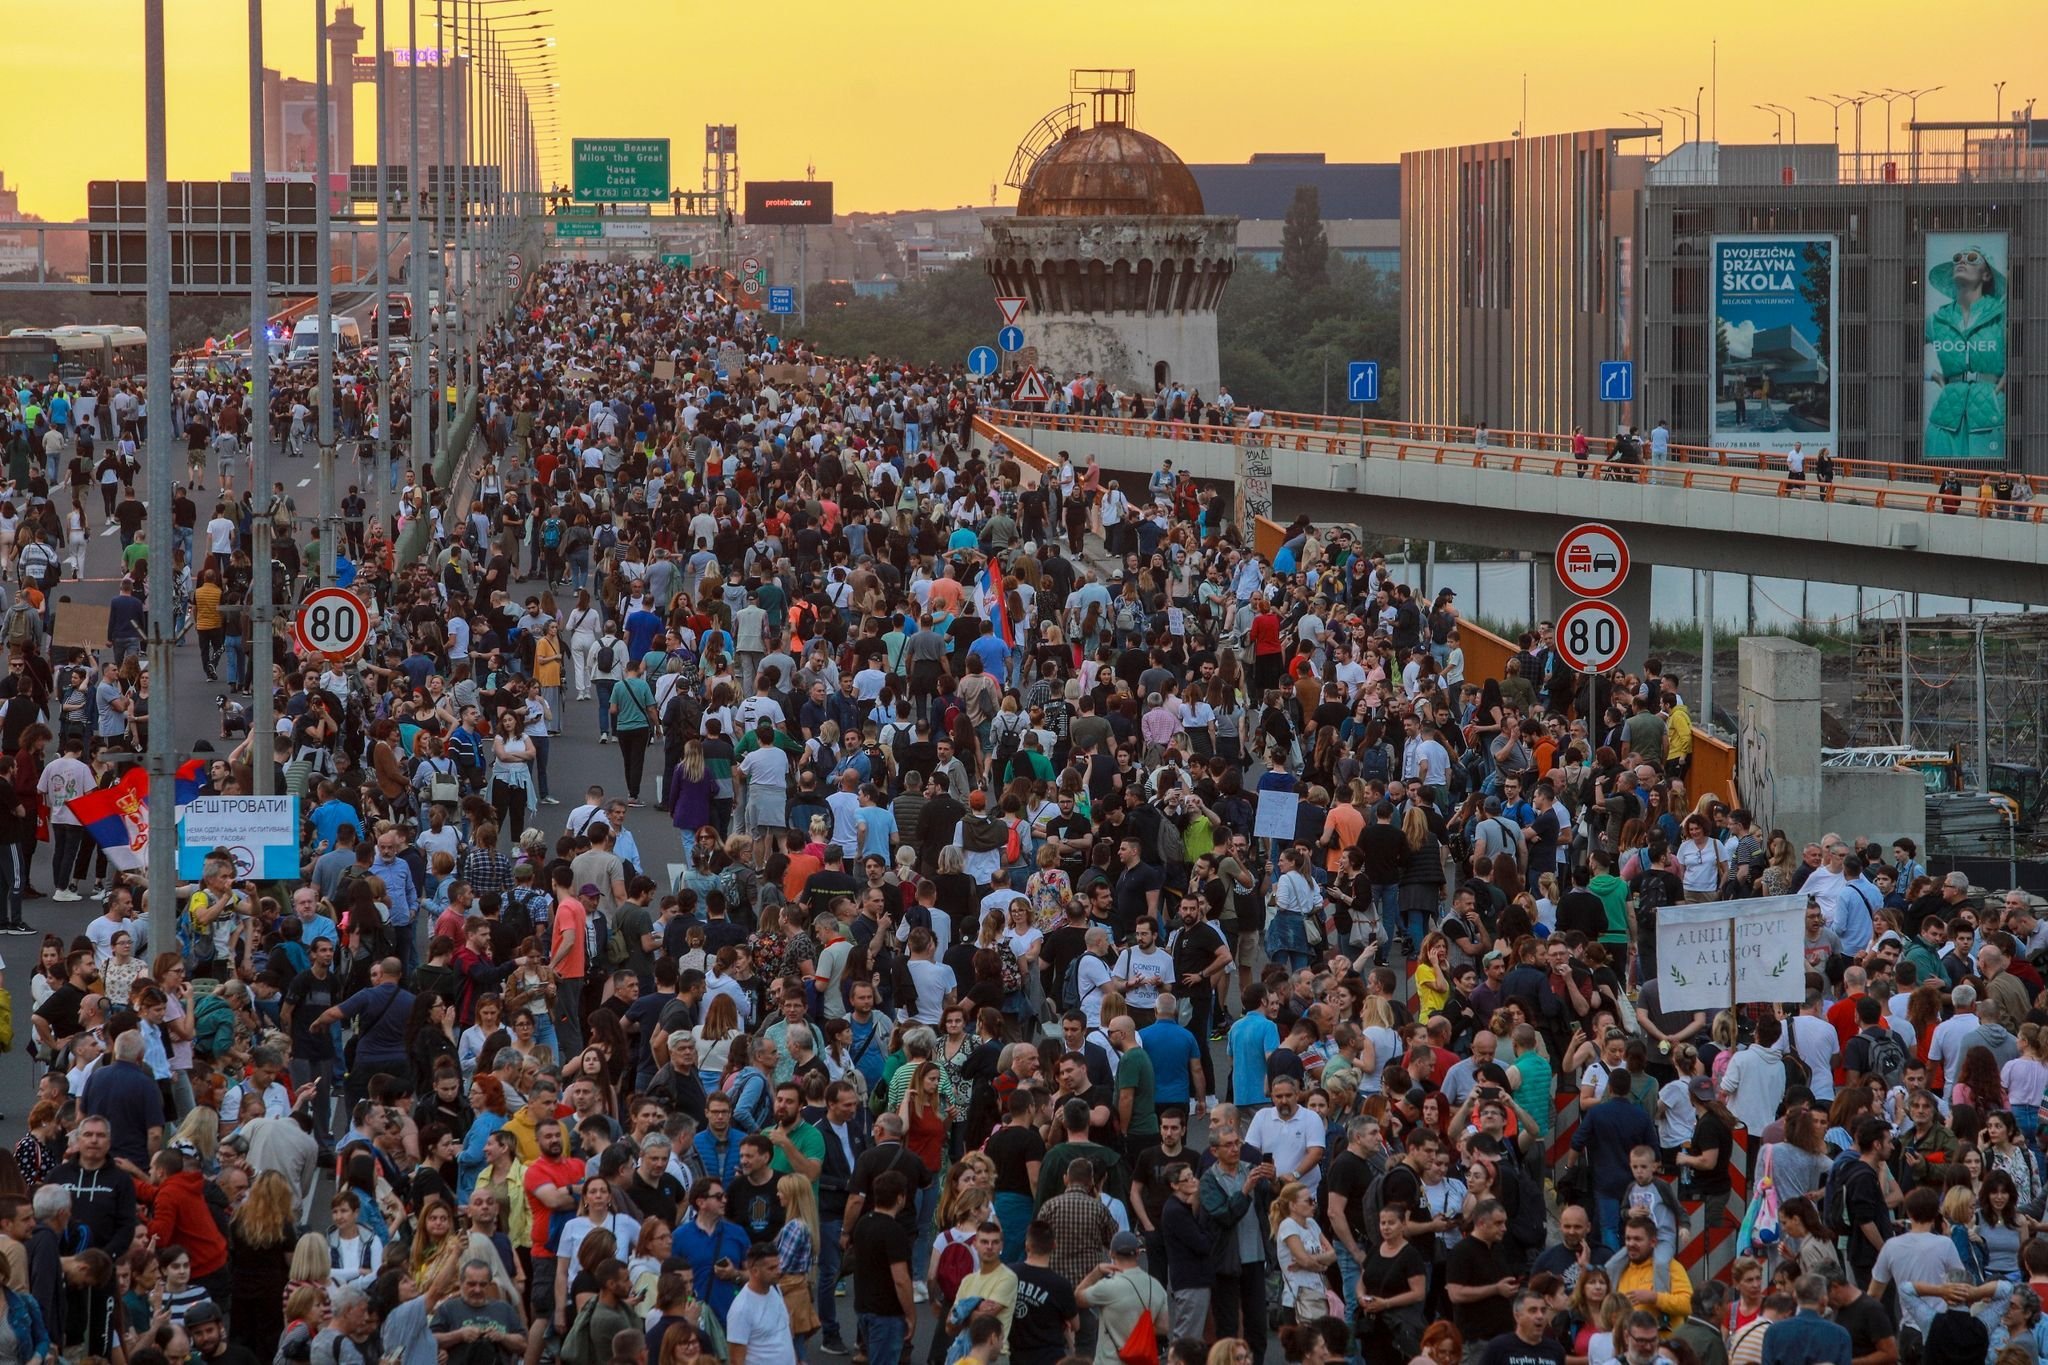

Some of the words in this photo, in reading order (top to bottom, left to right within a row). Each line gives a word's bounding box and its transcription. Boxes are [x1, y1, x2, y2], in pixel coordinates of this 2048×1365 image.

[583, 143, 616, 152] Милош
[623, 143, 659, 152] Велики
[579, 153, 605, 162] Milos
[613, 153, 629, 162] the
[636, 153, 663, 162] Great
[606, 165, 636, 173] Чачак
[606, 174, 636, 184] Čačak
[765, 199, 812, 208] proteinbox.rs
[1723, 246, 1796, 259] DVOJEZIČNA
[1723, 257, 1796, 271] DRŽAVNA
[745, 281, 757, 292] 80
[1722, 271, 1795, 291] ŠKOLA
[1933, 340, 1997, 352] BOGNER
[311, 606, 354, 642] 80
[1569, 618, 1615, 655] 80
[1018, 1280, 1049, 1304] RBIA
